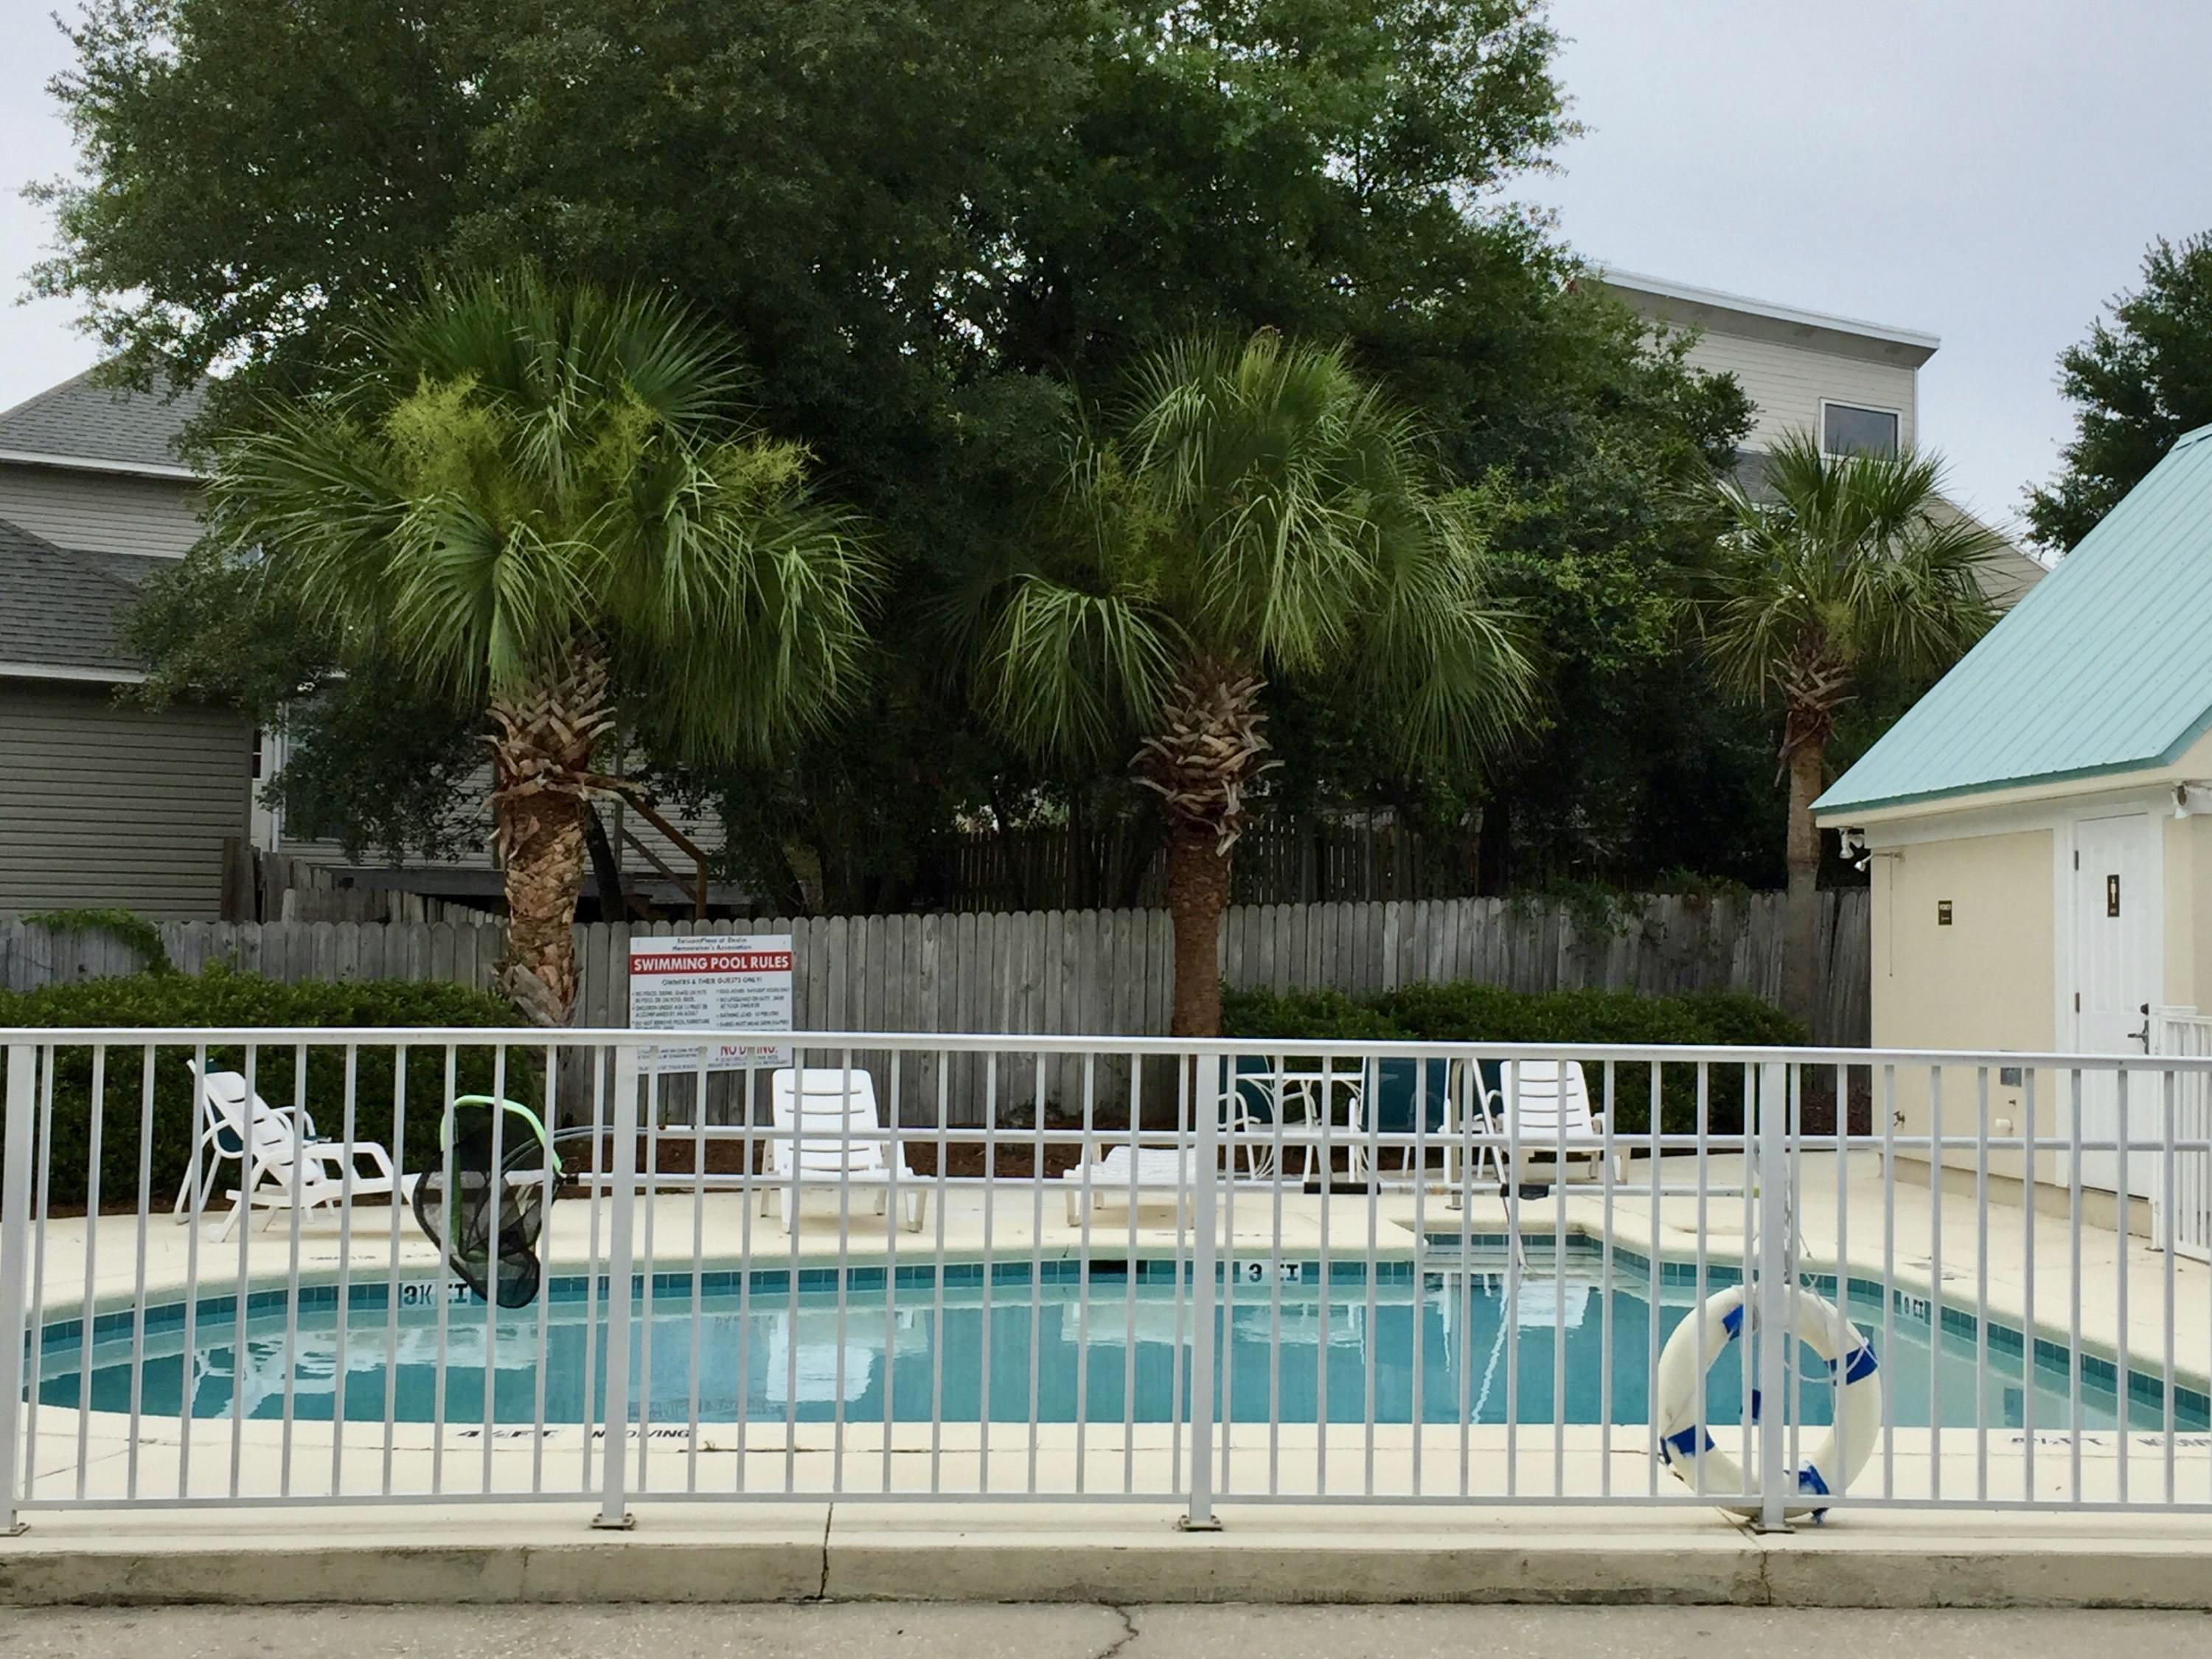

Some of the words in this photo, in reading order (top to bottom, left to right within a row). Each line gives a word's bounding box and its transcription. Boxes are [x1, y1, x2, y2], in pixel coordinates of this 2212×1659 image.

[634, 958, 708, 971] SWIMMING
[711, 956, 747, 970] POOL
[751, 956, 789, 968] RULES
